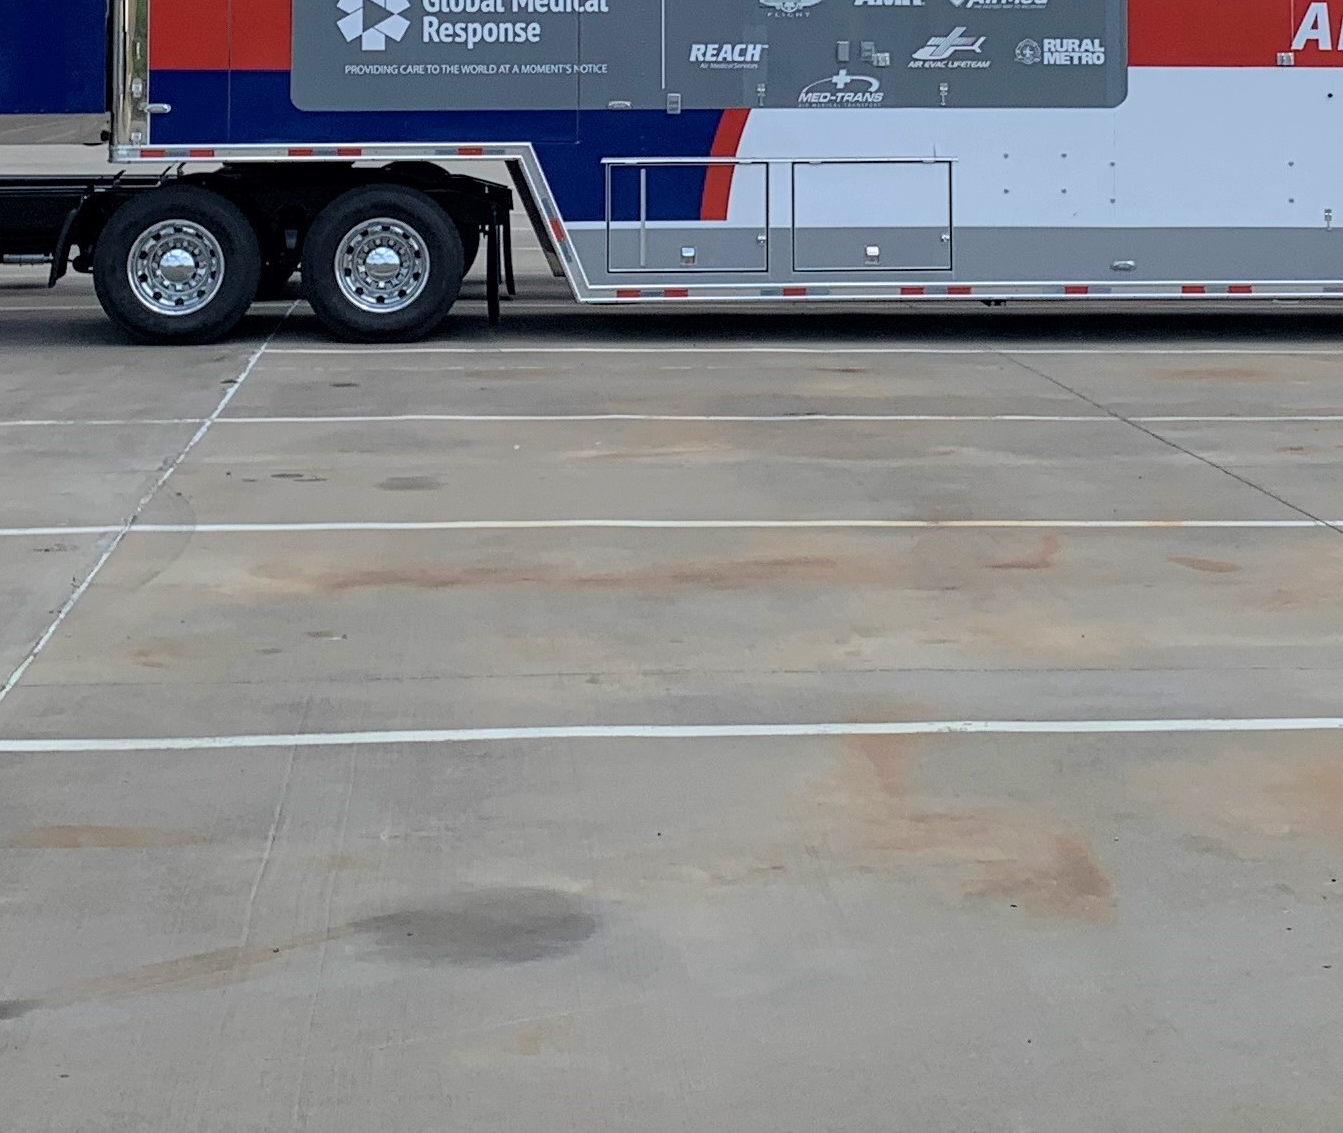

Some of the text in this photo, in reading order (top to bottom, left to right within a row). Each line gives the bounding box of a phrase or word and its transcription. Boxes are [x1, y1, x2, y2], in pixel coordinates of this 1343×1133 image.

[422, 16, 541, 50] Response
[1043, 38, 1105, 52] RURAL
[689, 44, 762, 62] REACH
[1043, 52, 1105, 65] METRO
[345, 65, 398, 75] PROVIDING
[400, 65, 425, 75] CARE
[426, 65, 440, 75] TO
[441, 65, 460, 75] THE
[460, 65, 497, 75] WORLD
[498, 64, 511, 74] AT
[511, 64, 520, 74] A
[521, 64, 572, 74] MOMENT'S
[798, 92, 884, 102] MED-TRANS
